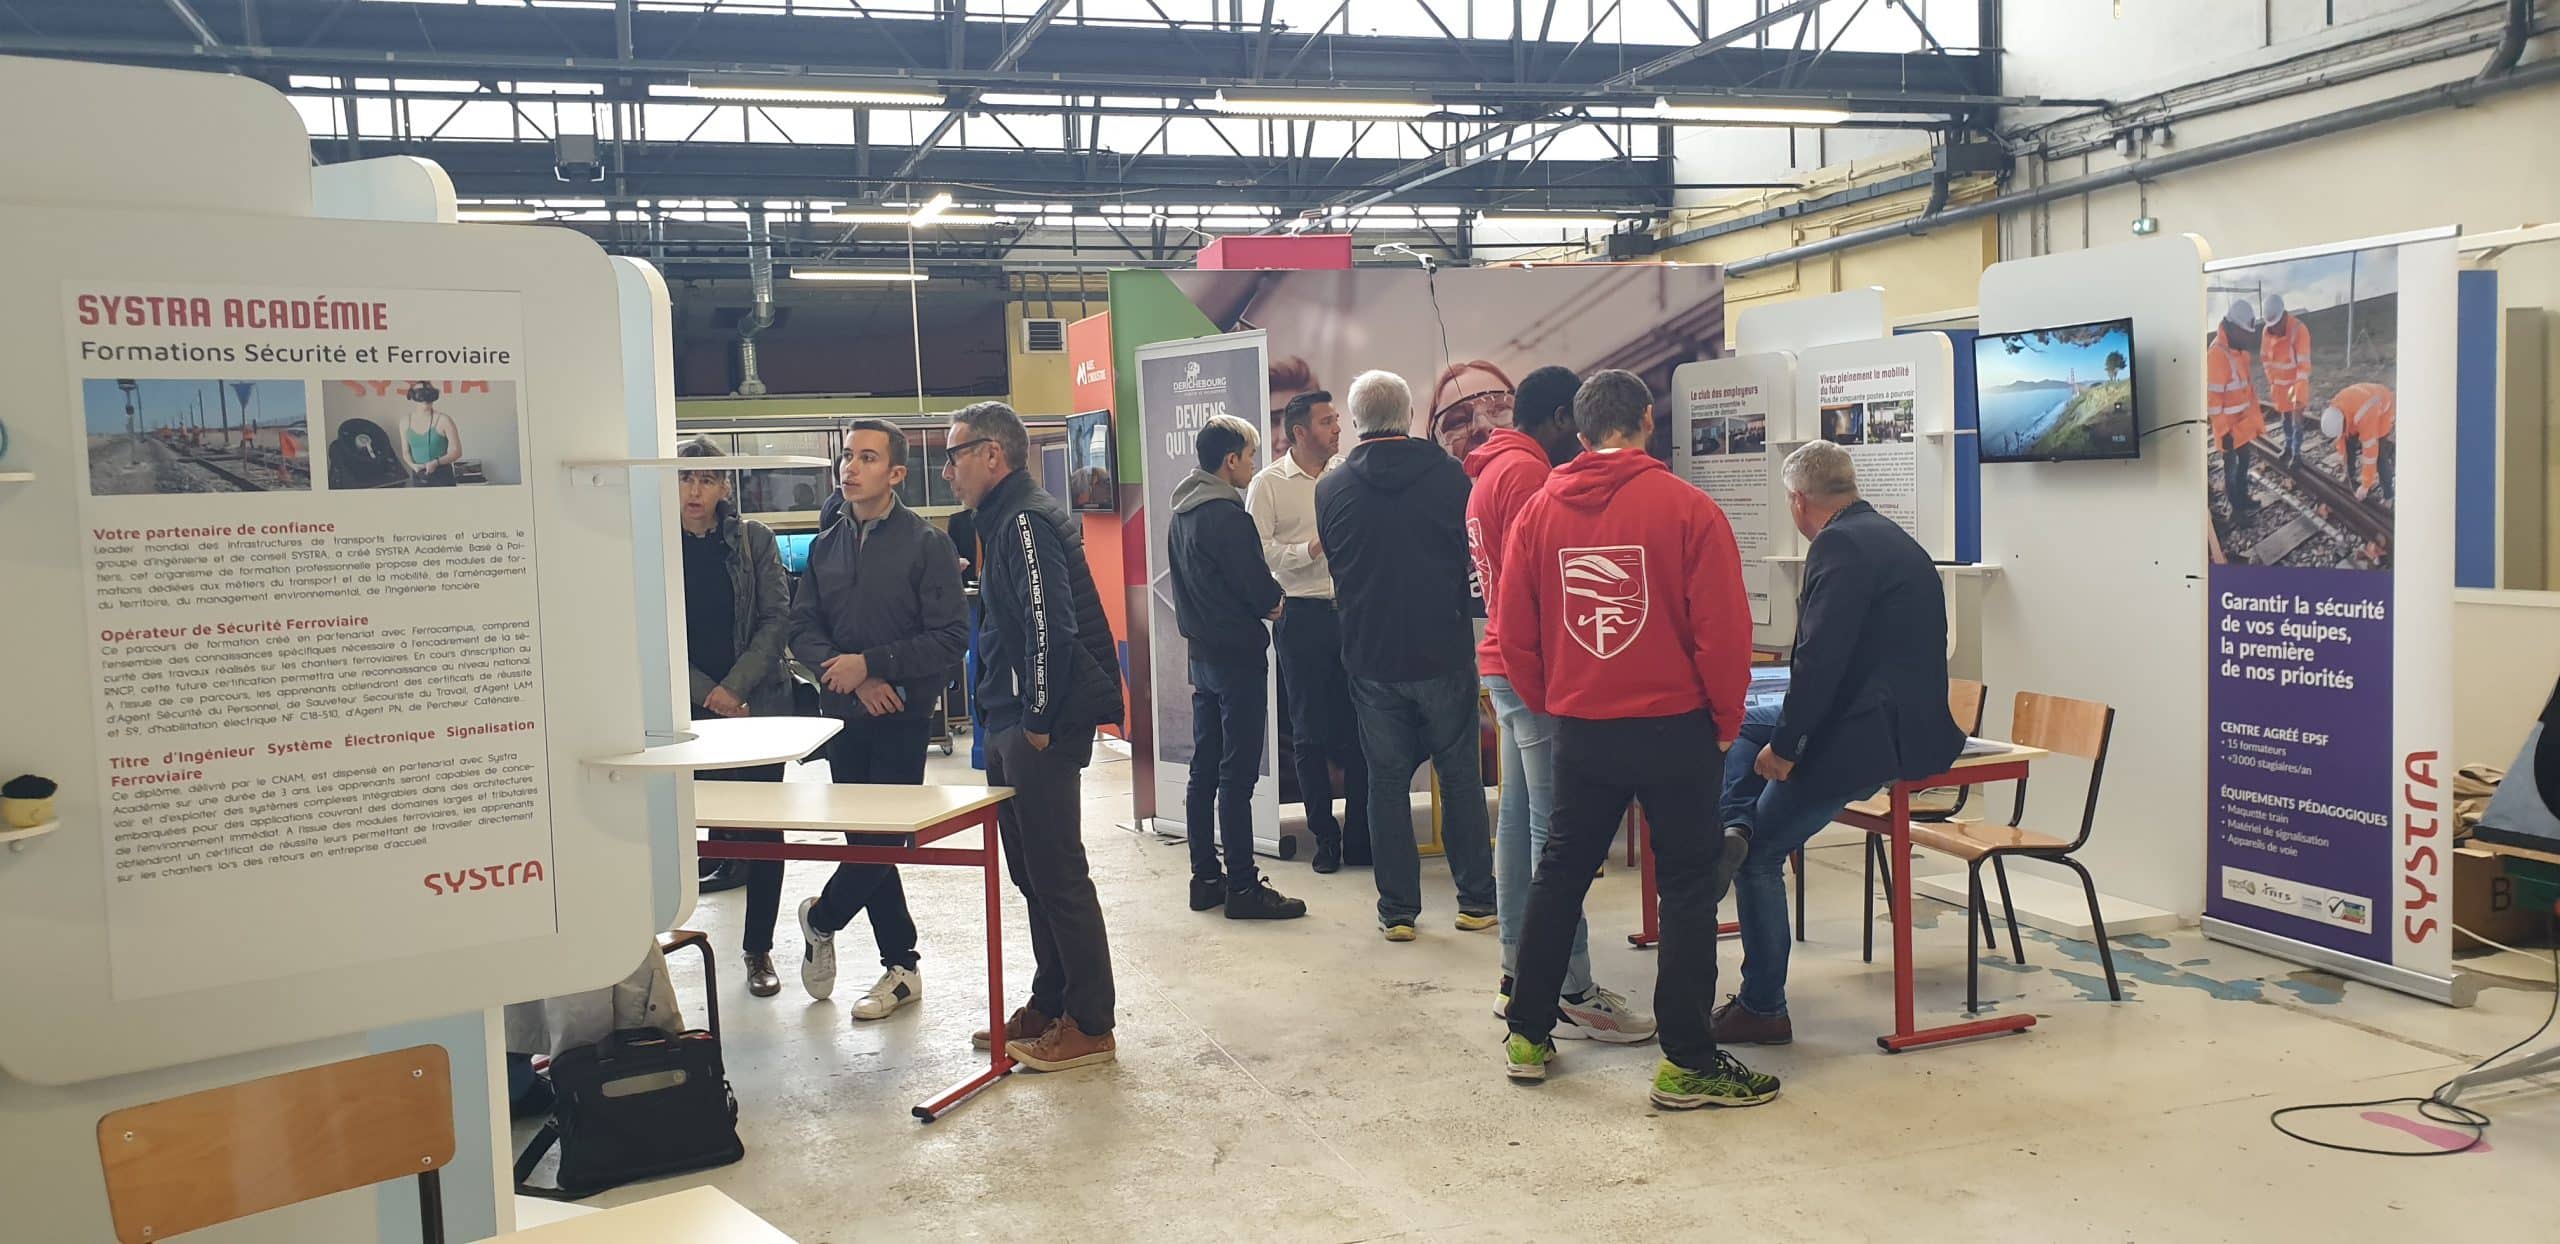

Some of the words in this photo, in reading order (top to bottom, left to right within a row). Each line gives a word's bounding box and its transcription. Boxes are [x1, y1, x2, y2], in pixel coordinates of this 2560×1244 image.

[78, 294, 212, 327] SYSTRA
[224, 294, 388, 330] ACADÉMIE
[82, 341, 235, 361] Formations
[245, 344, 347, 363] Sécurité
[356, 347, 379, 363] et
[388, 346, 510, 364] Ferroviaire
[92, 528, 140, 539] Votre
[145, 525, 232, 540] partenaire
[236, 524, 256, 535] de
[260, 522, 334, 534] confiance
[2221, 592, 2289, 613] Garantir
[2295, 595, 2309, 614] la
[2315, 598, 2385, 620] sécurité
[101, 626, 187, 642] Opérateur
[192, 624, 212, 635] de
[217, 619, 281, 634] Sécurité
[286, 615, 368, 630] Ferroviaire
[2221, 614, 2240, 632] de
[2246, 621, 2274, 635] vos
[2281, 618, 2352, 644] équipes,
[2221, 636, 2234, 654] la
[2239, 641, 2314, 662] première
[2221, 659, 2240, 677] de
[2246, 666, 2276, 680] nos
[2281, 666, 2354, 689] priorités
[109, 755, 149, 767] Titre
[163, 746, 255, 763] d'Ingénieur
[267, 739, 332, 755] Système
[344, 730, 435, 746] Électronique
[446, 720, 534, 739] Signalisation
[2221, 721, 2260, 737] CENTRE
[2263, 727, 2299, 742] AGRÉÉ
[2302, 733, 2329, 746] EPSF
[2228, 739, 2238, 749] 15
[2239, 740, 2287, 756] formateurs
[112, 769, 202, 786] Ferroviaire
[2221, 784, 2295, 809] ÉQUIPEMENTS
[2299, 799, 2388, 827] PÉDAGOGIQUES
[2227, 804, 2267, 821] Maquette
[2269, 811, 2289, 824] train
[2227, 819, 2261, 834] Matériel
[2263, 825, 2274, 837] de
[2275, 829, 2329, 848] signalisation
[2227, 834, 2265, 850] Appareils
[2267, 841, 2277, 852] de
[2279, 845, 2299, 857] voie
[2404, 750, 2439, 944] SYSTRA
[423, 859, 544, 896] SYSTRA
